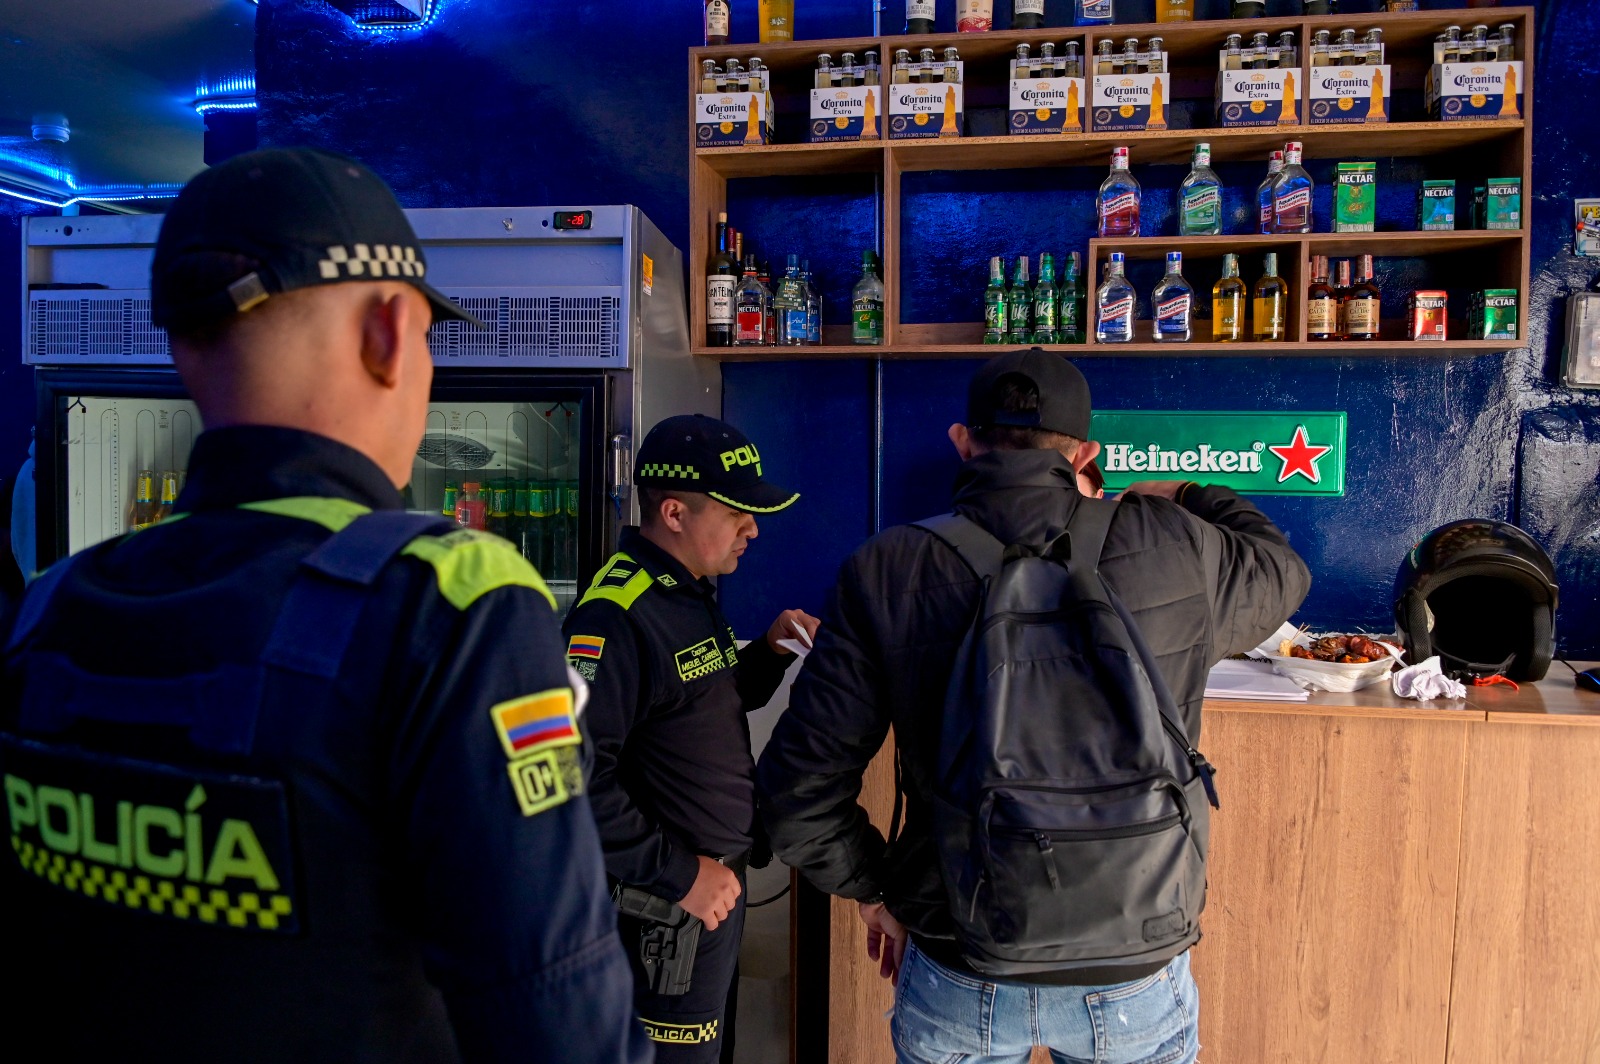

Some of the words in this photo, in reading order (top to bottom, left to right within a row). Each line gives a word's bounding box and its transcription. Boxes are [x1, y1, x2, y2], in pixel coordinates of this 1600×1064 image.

[1322, 78, 1369, 90] Coronita
[1454, 74, 1501, 87] Coronita
[1104, 86, 1149, 98] Coronita
[1234, 81, 1281, 93] Coronita
[900, 94, 942, 106] Coronita
[1021, 89, 1065, 102] Coronita
[821, 98, 862, 110] Coronita
[1033, 99, 1054, 107] Extra
[706, 104, 746, 115] Coronita
[1339, 174, 1373, 183] NECTAR
[1425, 189, 1454, 197] NECTAR
[1489, 187, 1518, 195] NECTAR
[1415, 300, 1444, 308] NECTAR
[1485, 298, 1515, 306] NECTAR
[719, 443, 762, 472] POLI
[681, 657, 703, 673] MIGUEL
[4, 773, 280, 891] POLICÍA
[643, 1026, 695, 1041] OLICÍA
